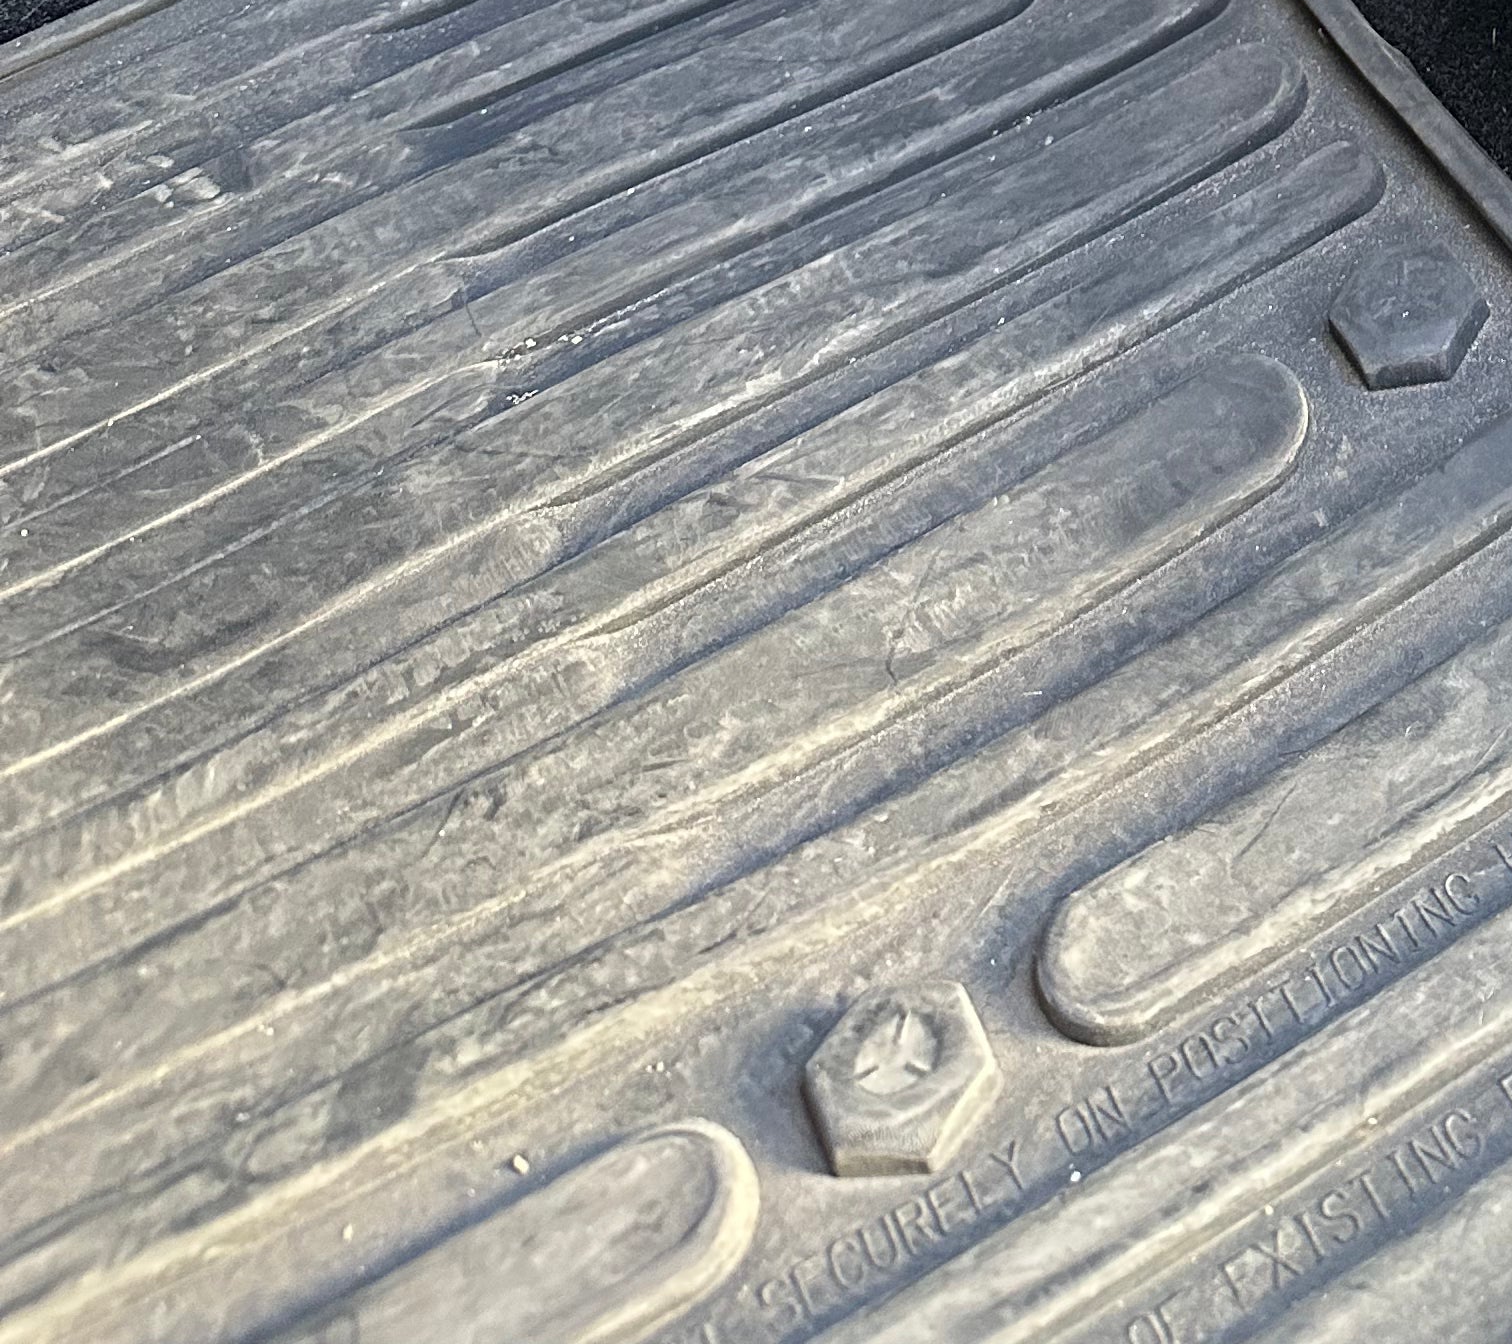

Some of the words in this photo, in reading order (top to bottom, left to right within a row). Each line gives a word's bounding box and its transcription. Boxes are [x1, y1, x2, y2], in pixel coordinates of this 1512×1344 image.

[757, 1140, 1026, 1320] SECURELY
[1055, 1085, 1132, 1155] ON
[1148, 872, 1482, 1100] POSITIONING
[1218, 1110, 1487, 1312] EXISTING
